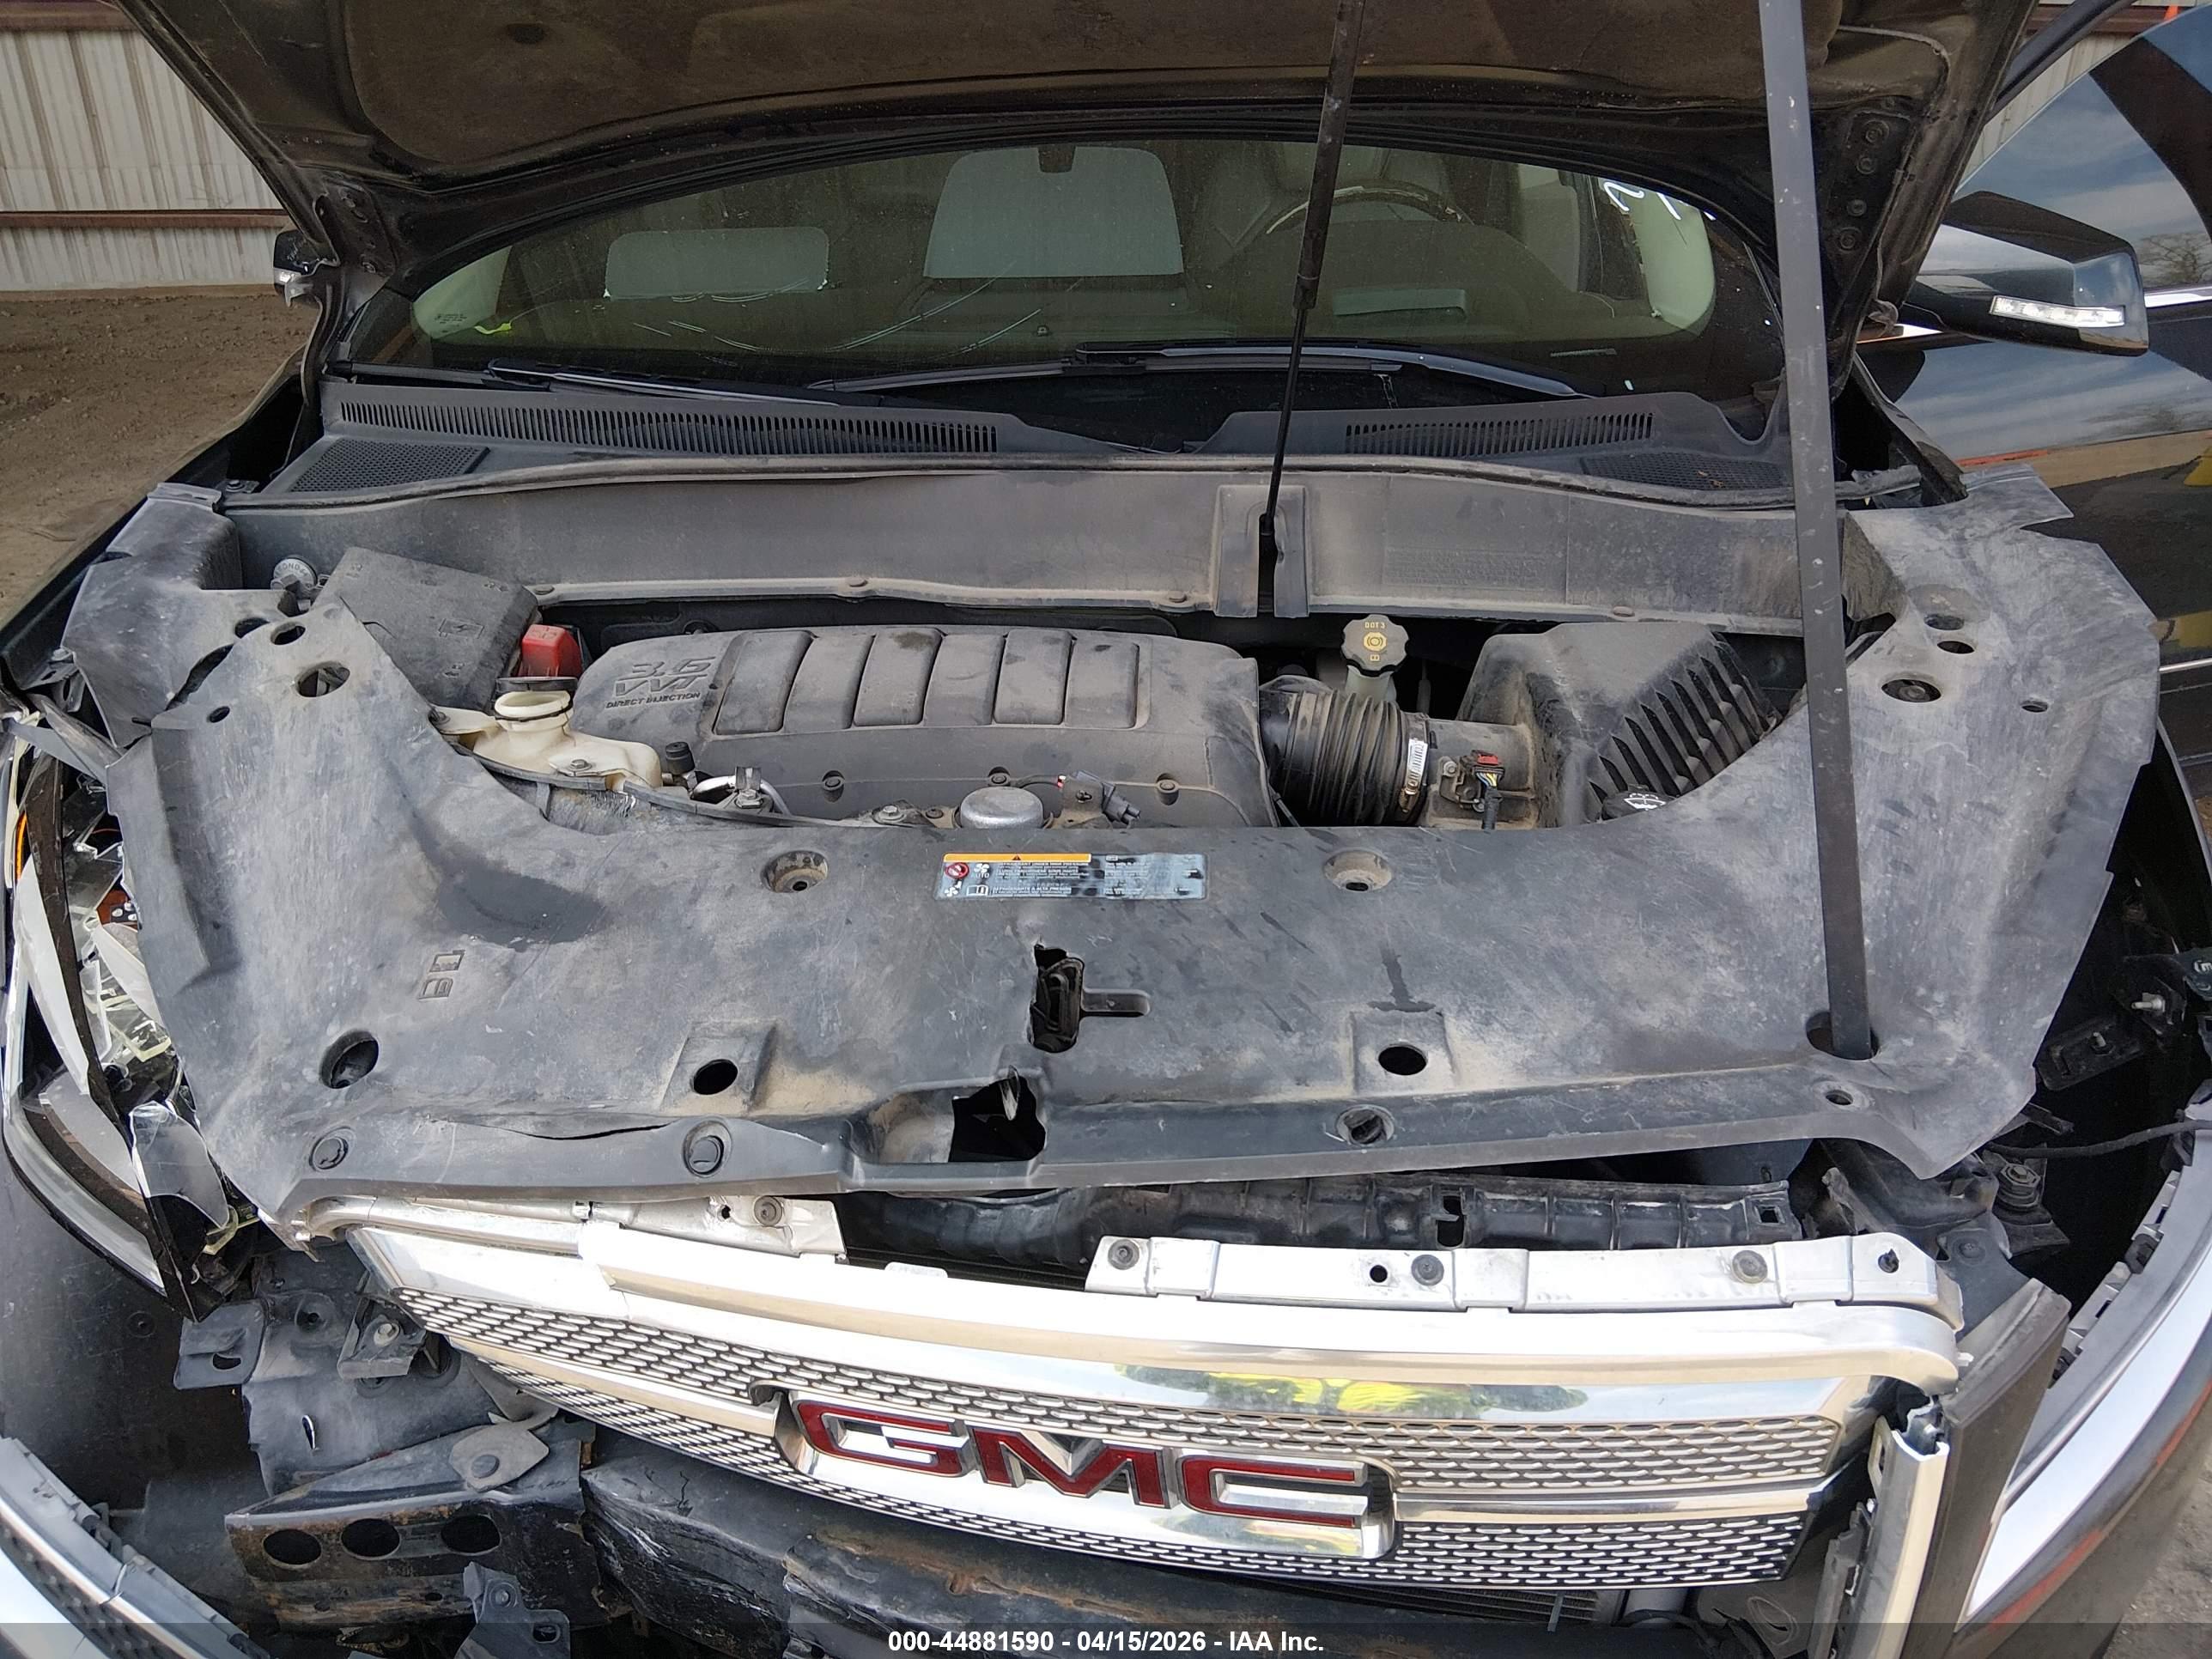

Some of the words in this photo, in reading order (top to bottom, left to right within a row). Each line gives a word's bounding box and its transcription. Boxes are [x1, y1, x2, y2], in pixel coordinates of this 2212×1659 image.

[617, 656, 716, 681] 3.6
[615, 673, 708, 696] VVT
[605, 698, 645, 708] DIRECT
[645, 692, 701, 703] INJECTION
[794, 1399, 1368, 1528] GMC
